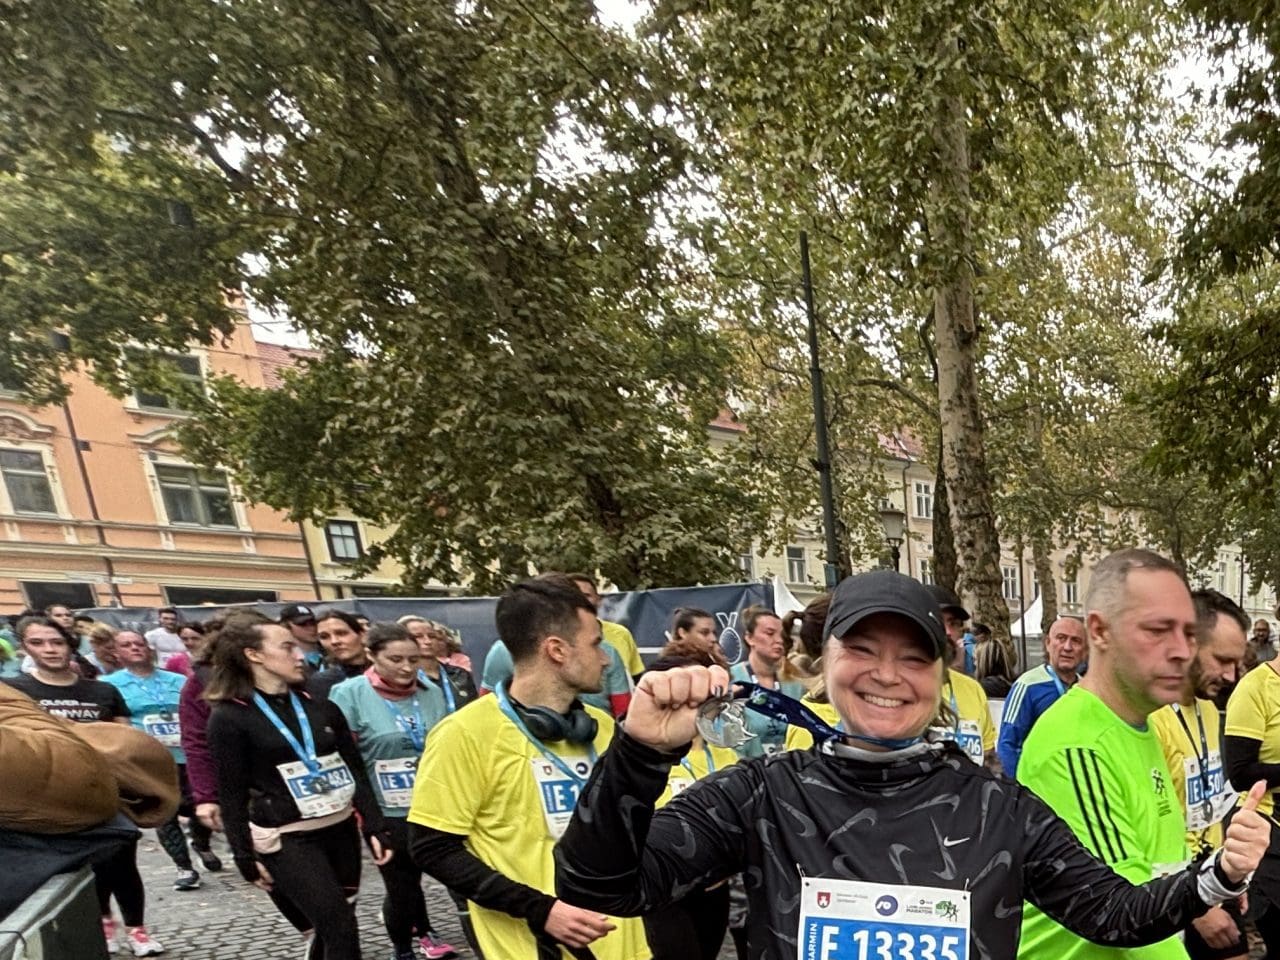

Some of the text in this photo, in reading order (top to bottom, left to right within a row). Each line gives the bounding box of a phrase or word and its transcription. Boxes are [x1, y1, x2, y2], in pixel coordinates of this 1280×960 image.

[389, 775, 399, 788] E
[1194, 780, 1200, 799] E
[552, 784, 567, 811] E
